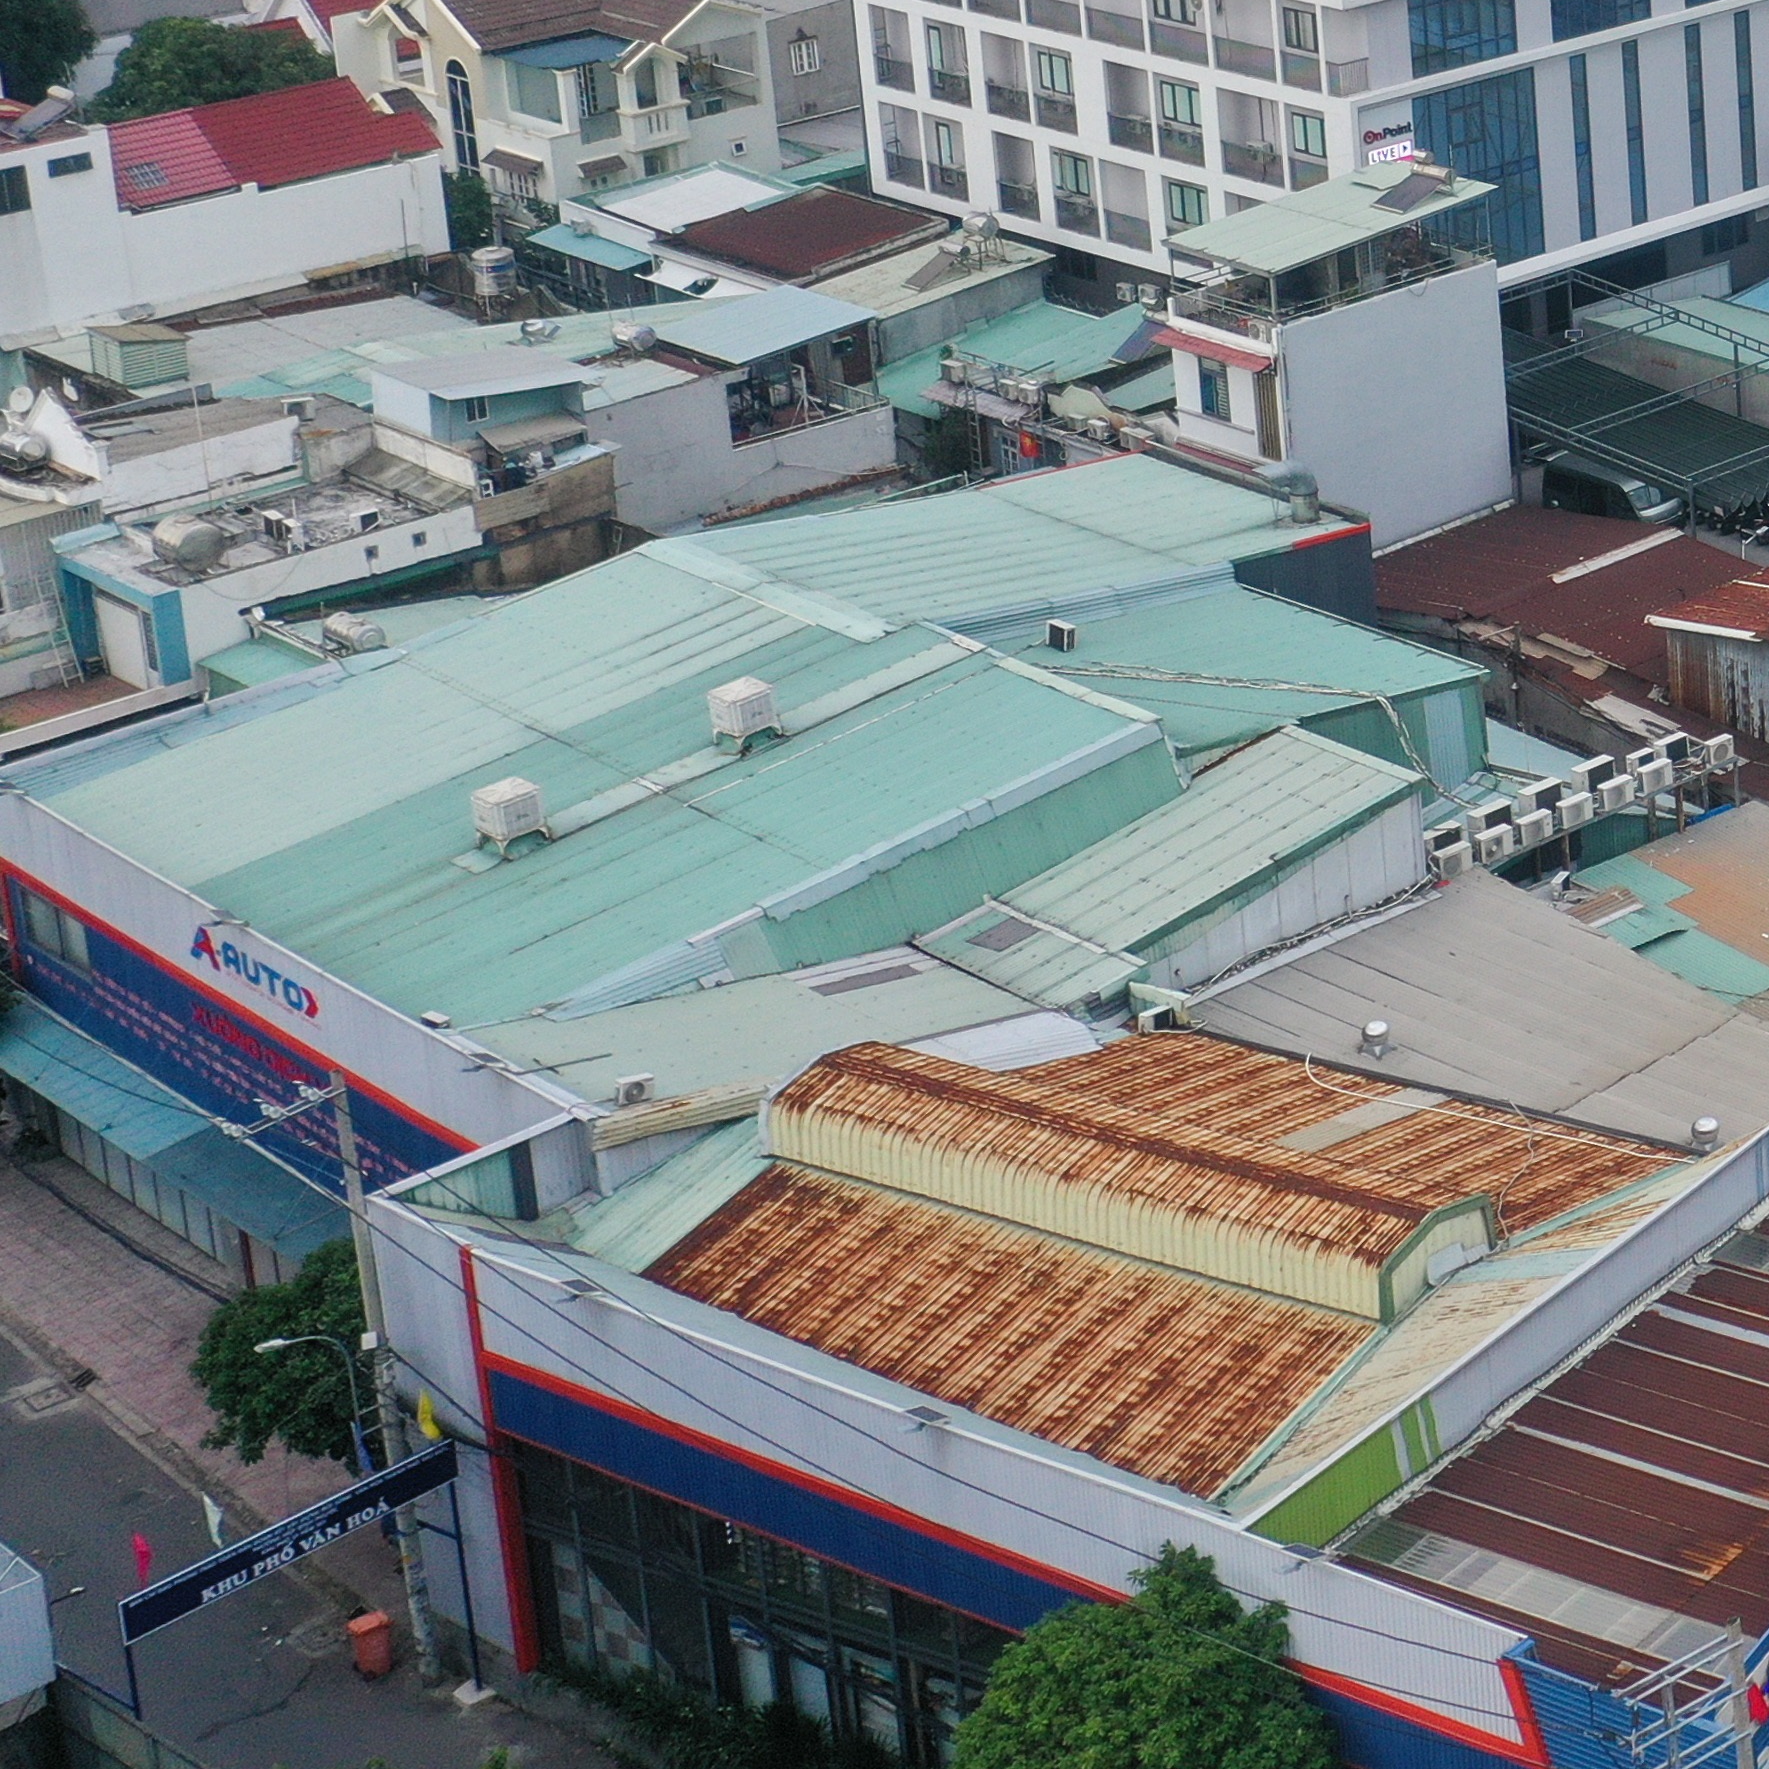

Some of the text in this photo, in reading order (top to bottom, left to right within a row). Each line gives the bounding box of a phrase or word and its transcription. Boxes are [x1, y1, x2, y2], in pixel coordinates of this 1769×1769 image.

[1363, 121, 1412, 145] OnPoint
[191, 925, 304, 1012] A-AUTO
[201, 1495, 392, 1604] KHU PHỐ VĂN HOÁ
